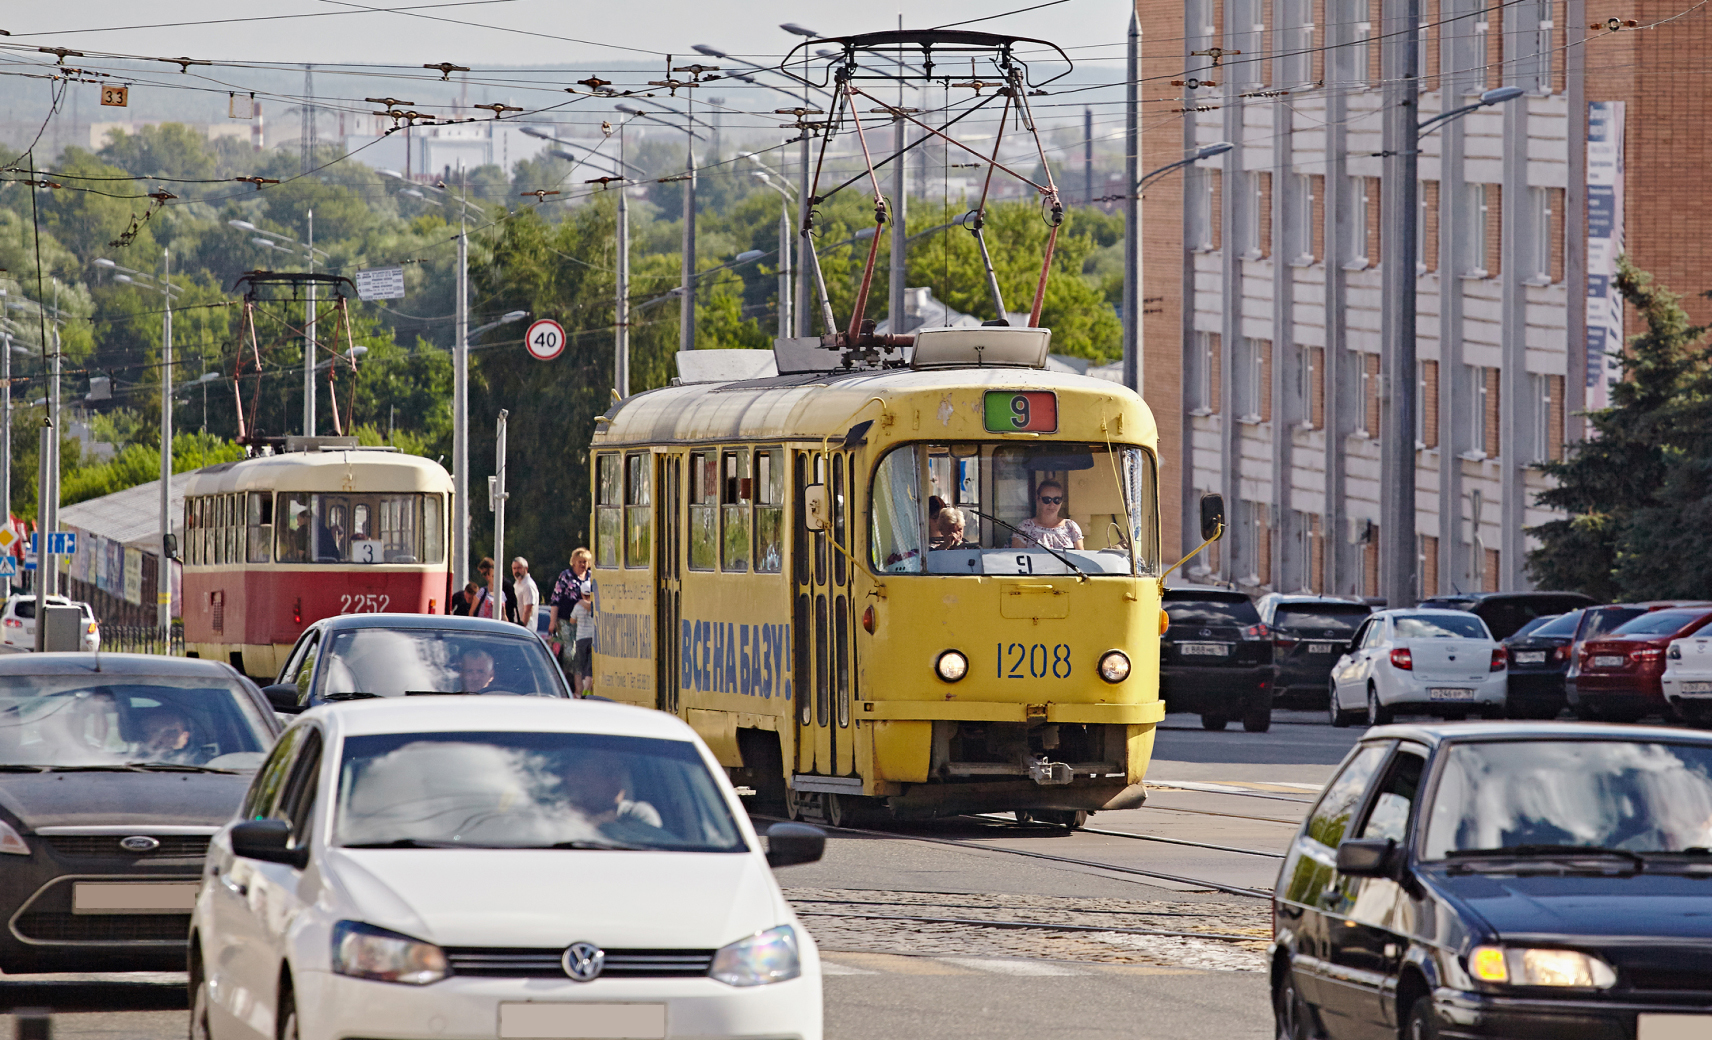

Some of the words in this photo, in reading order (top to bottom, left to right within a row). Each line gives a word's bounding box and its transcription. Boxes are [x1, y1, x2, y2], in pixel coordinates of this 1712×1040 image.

[534, 332, 557, 348] 40
[1010, 395, 1031, 428] 9
[363, 544, 373, 563] 3
[340, 594, 390, 615] 2252
[681, 619, 711, 693] ВСЕ
[713, 622, 738, 694] НА
[740, 623, 792, 701] БАЗУ!
[997, 643, 1072, 679] 1208
